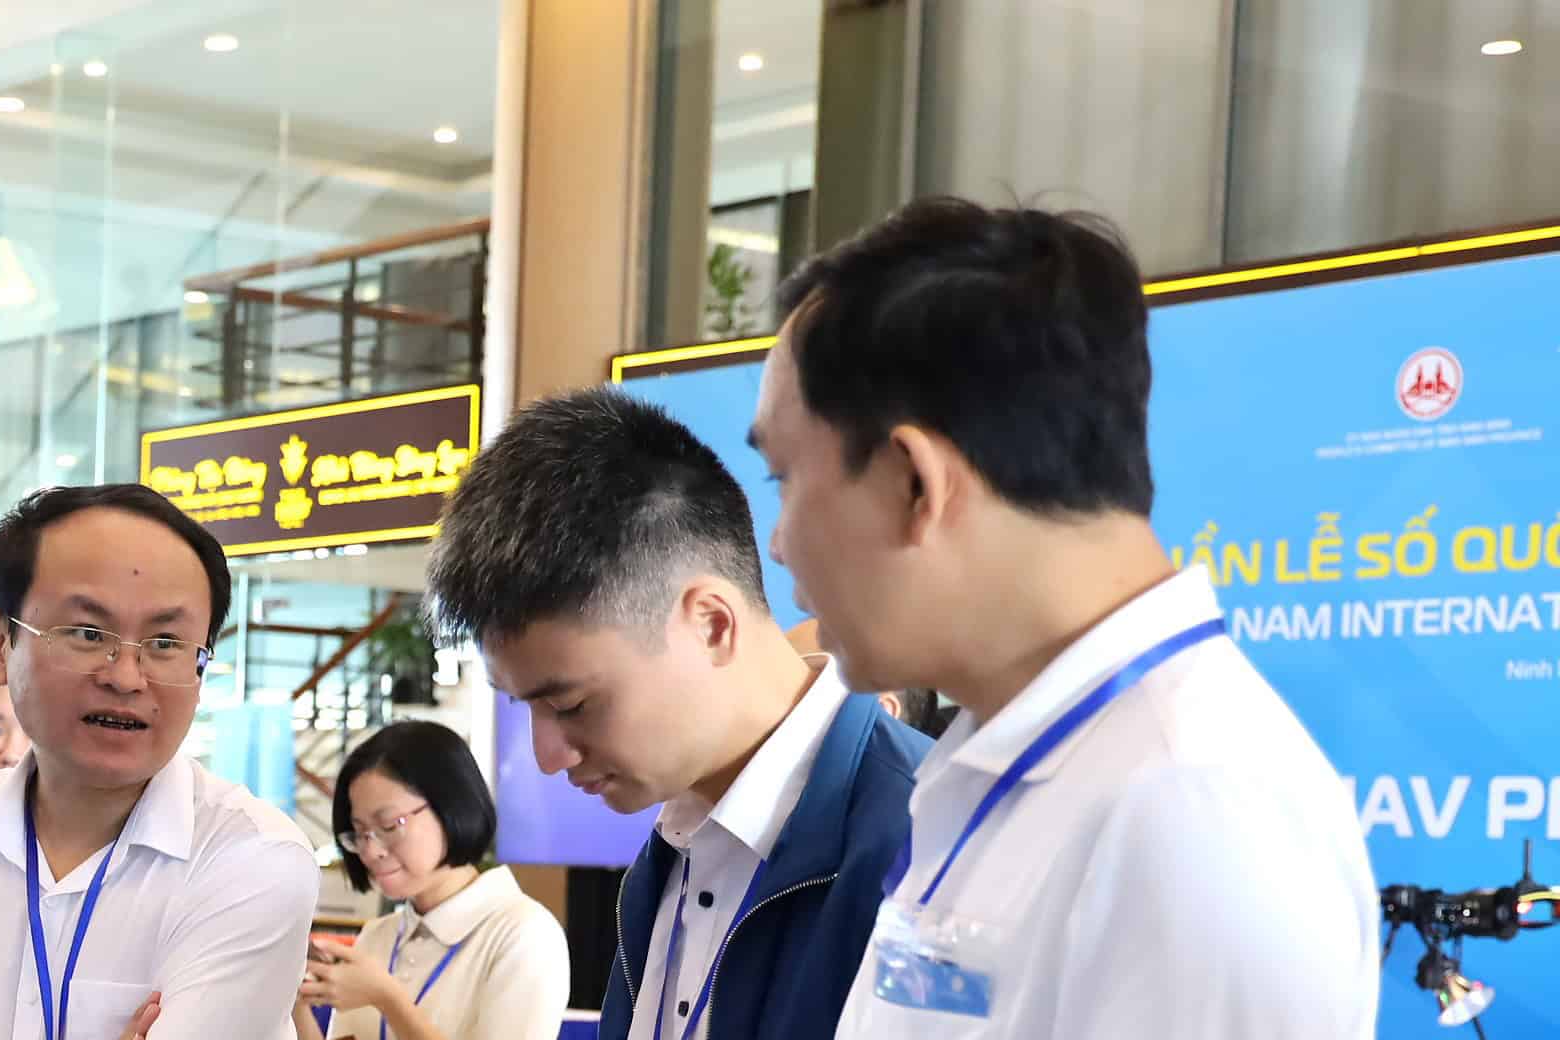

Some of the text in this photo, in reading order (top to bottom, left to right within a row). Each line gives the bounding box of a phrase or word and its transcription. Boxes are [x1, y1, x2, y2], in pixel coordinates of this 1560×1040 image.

[1275, 512, 1343, 583] LỄ
[1355, 505, 1438, 580] SỐ
[1231, 602, 1333, 642] NAM
[1340, 774, 1472, 838] AV
